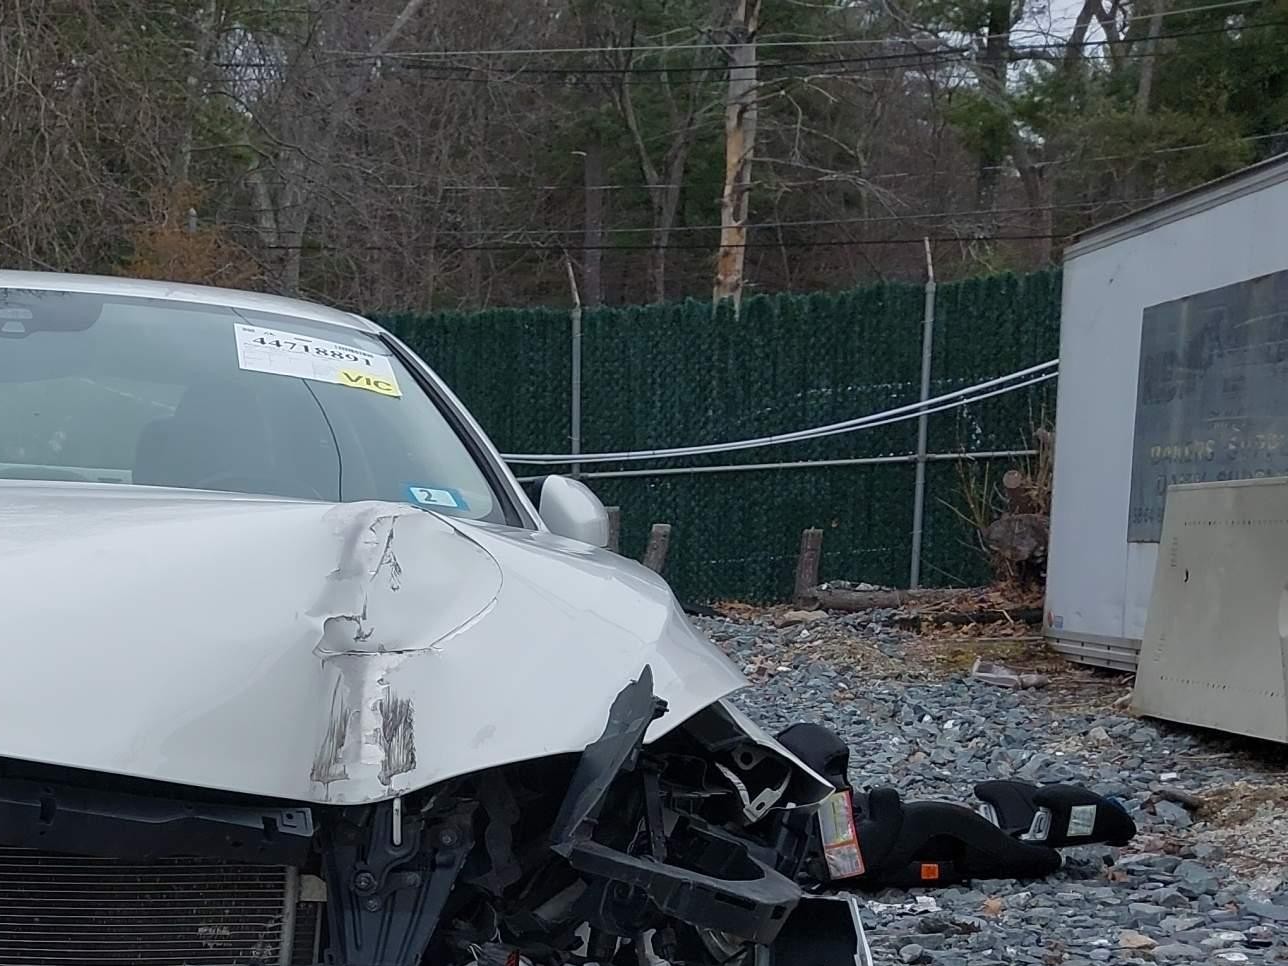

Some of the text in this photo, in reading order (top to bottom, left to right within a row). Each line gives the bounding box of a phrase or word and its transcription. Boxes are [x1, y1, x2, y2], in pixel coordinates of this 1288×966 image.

[252, 336, 372, 367] 44718891
[342, 371, 393, 392] VIC
[419, 489, 437, 503] 2
